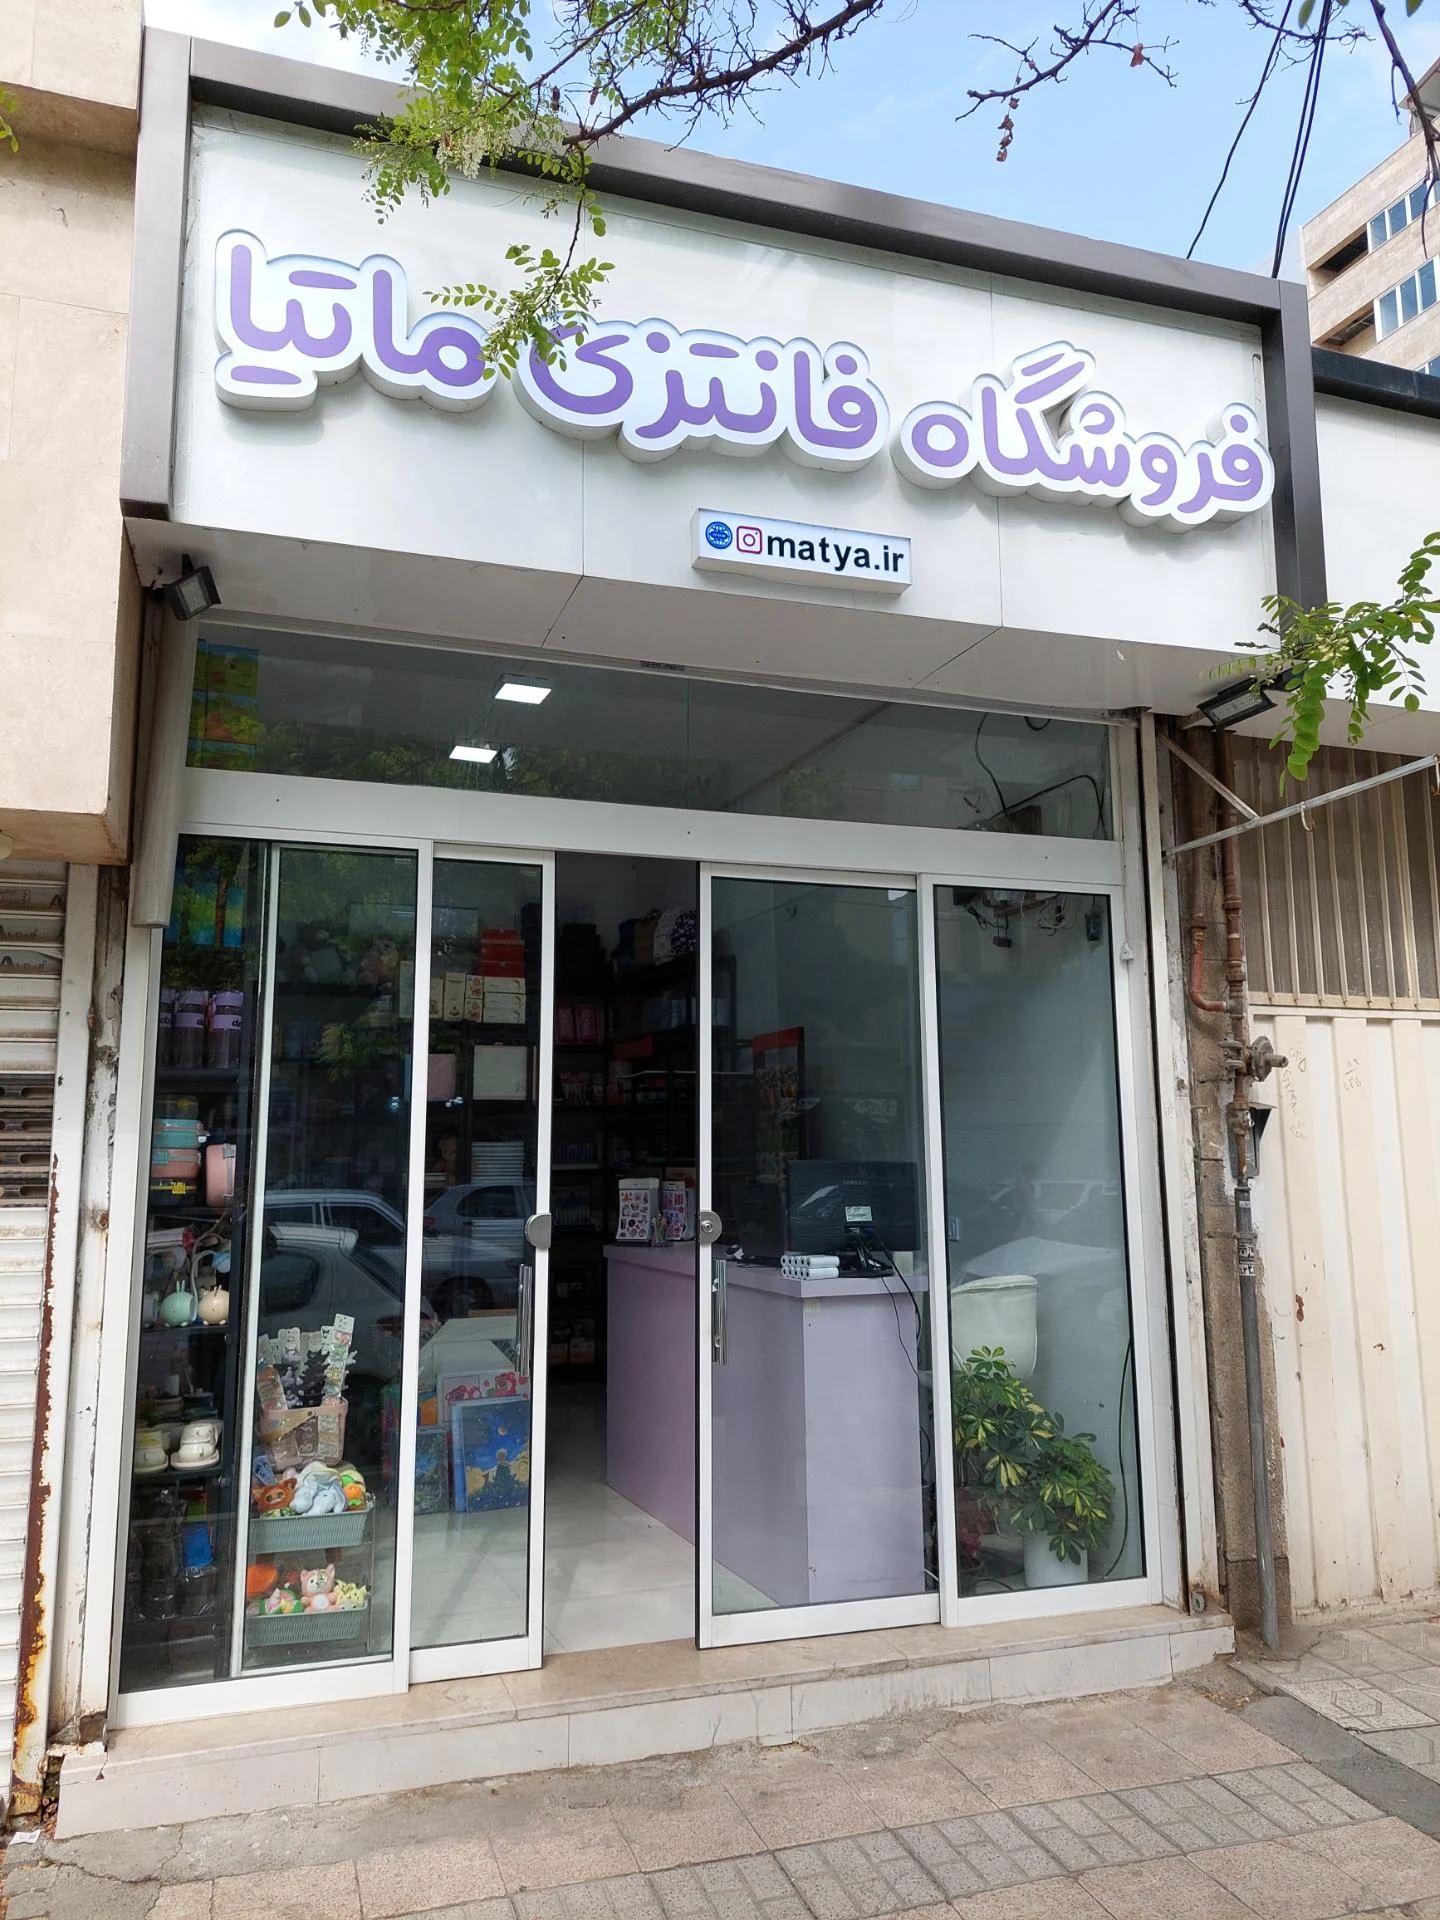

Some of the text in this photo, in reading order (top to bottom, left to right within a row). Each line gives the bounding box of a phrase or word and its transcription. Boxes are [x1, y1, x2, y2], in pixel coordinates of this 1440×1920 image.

[230, 243, 1264, 514] فروشگاه فانتزی ماتیا
[767, 534, 904, 573] matya.ir
